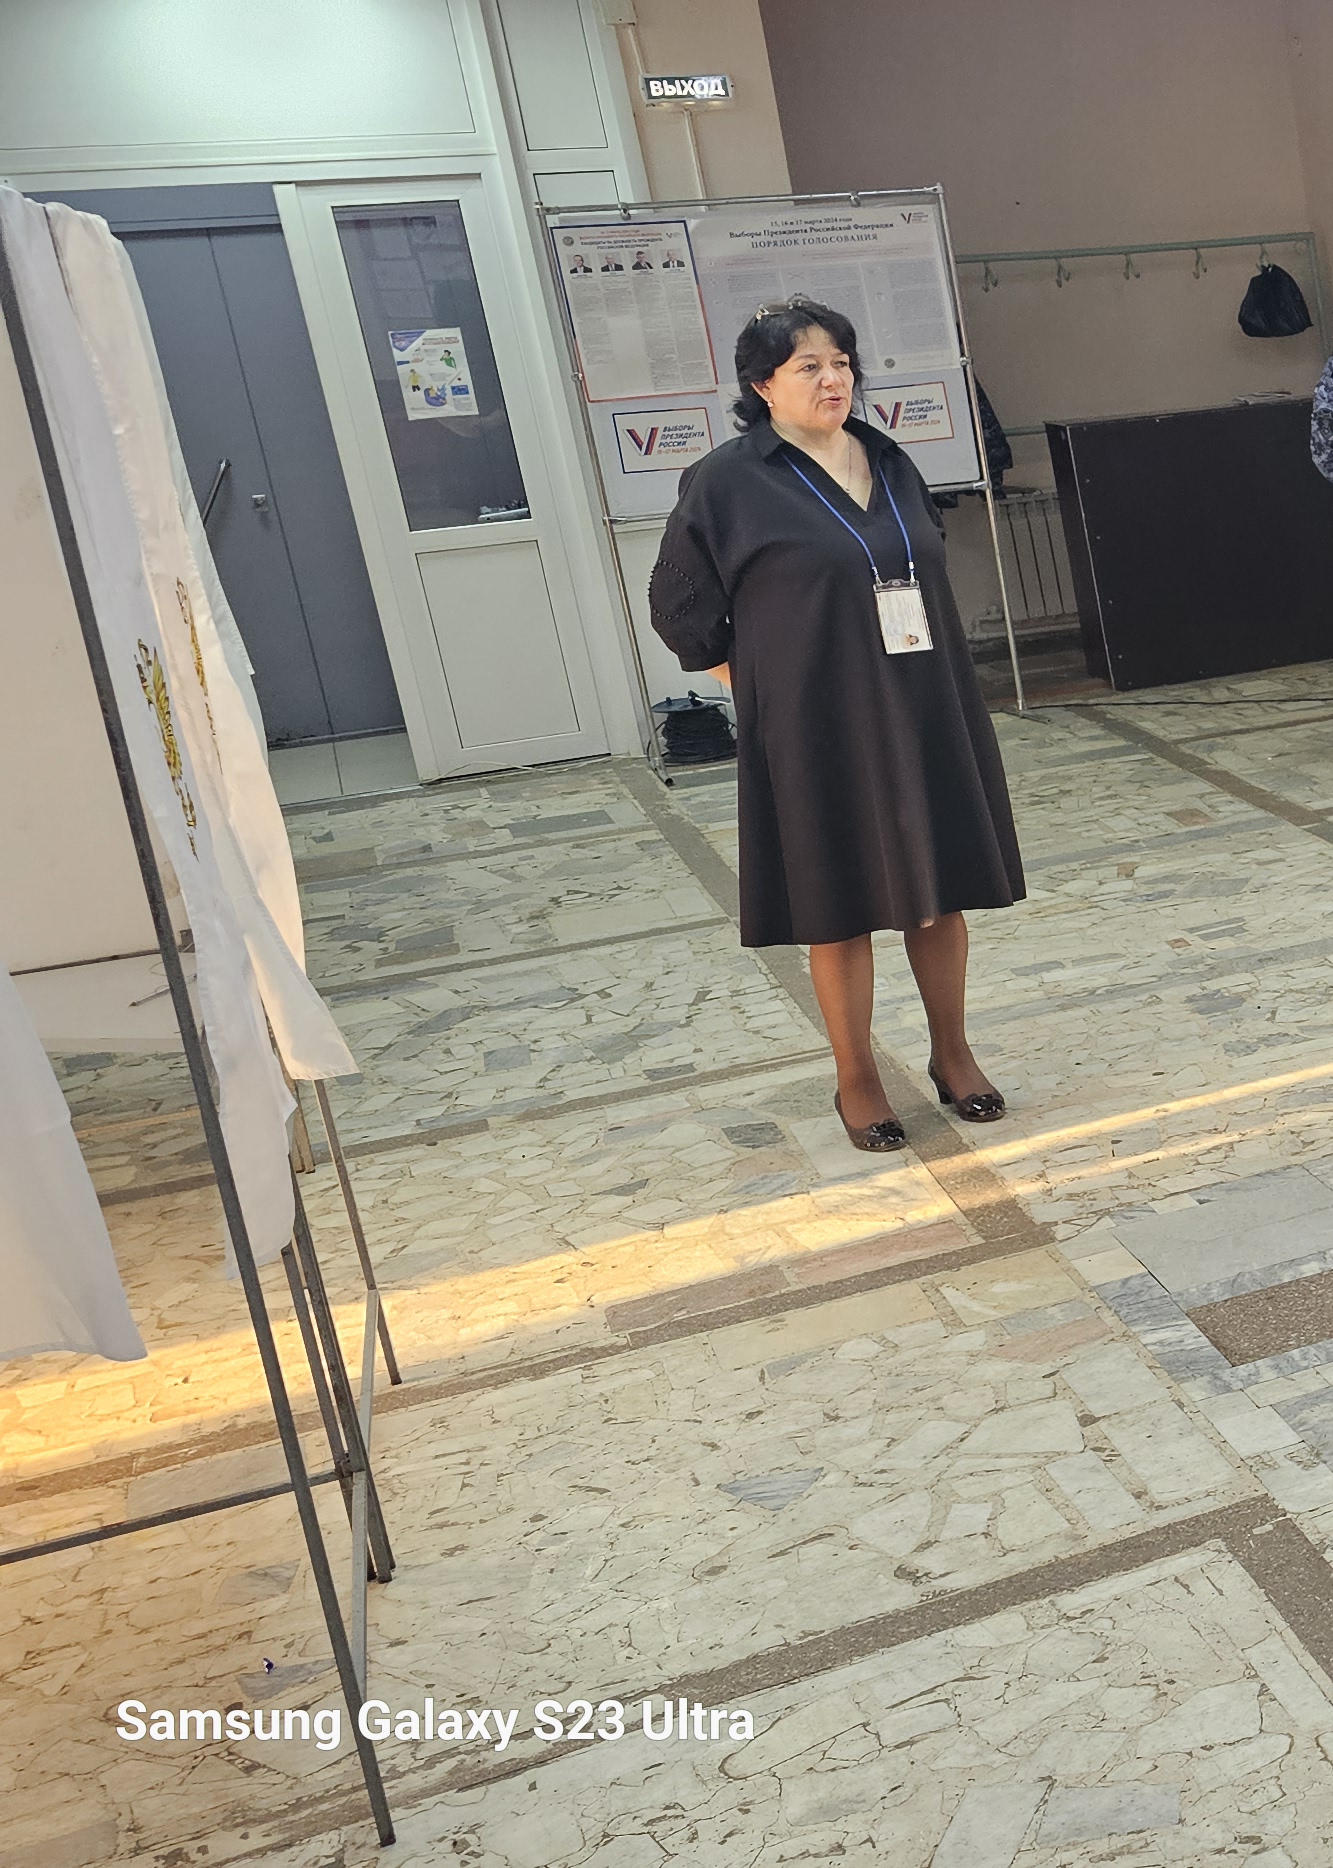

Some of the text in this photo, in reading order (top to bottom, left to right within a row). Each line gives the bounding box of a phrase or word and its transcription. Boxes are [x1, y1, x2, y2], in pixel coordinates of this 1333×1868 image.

[649, 79, 725, 97] ВЫХОД
[729, 222, 894, 238] Выборы Президента Российской Федерации
[751, 233, 878, 248] ПОРЯДОК ГОЛОСОВАНИЯ
[905, 398, 934, 407] ВЫБОРЫ
[903, 405, 944, 414] ПРЕЗИДЕНТА
[902, 414, 927, 422] РОССИИ
[663, 424, 695, 433] ВЫБОРЫ
[661, 431, 705, 441] ПРЕЗИДЕНТА
[658, 440, 687, 448] РОССИИ
